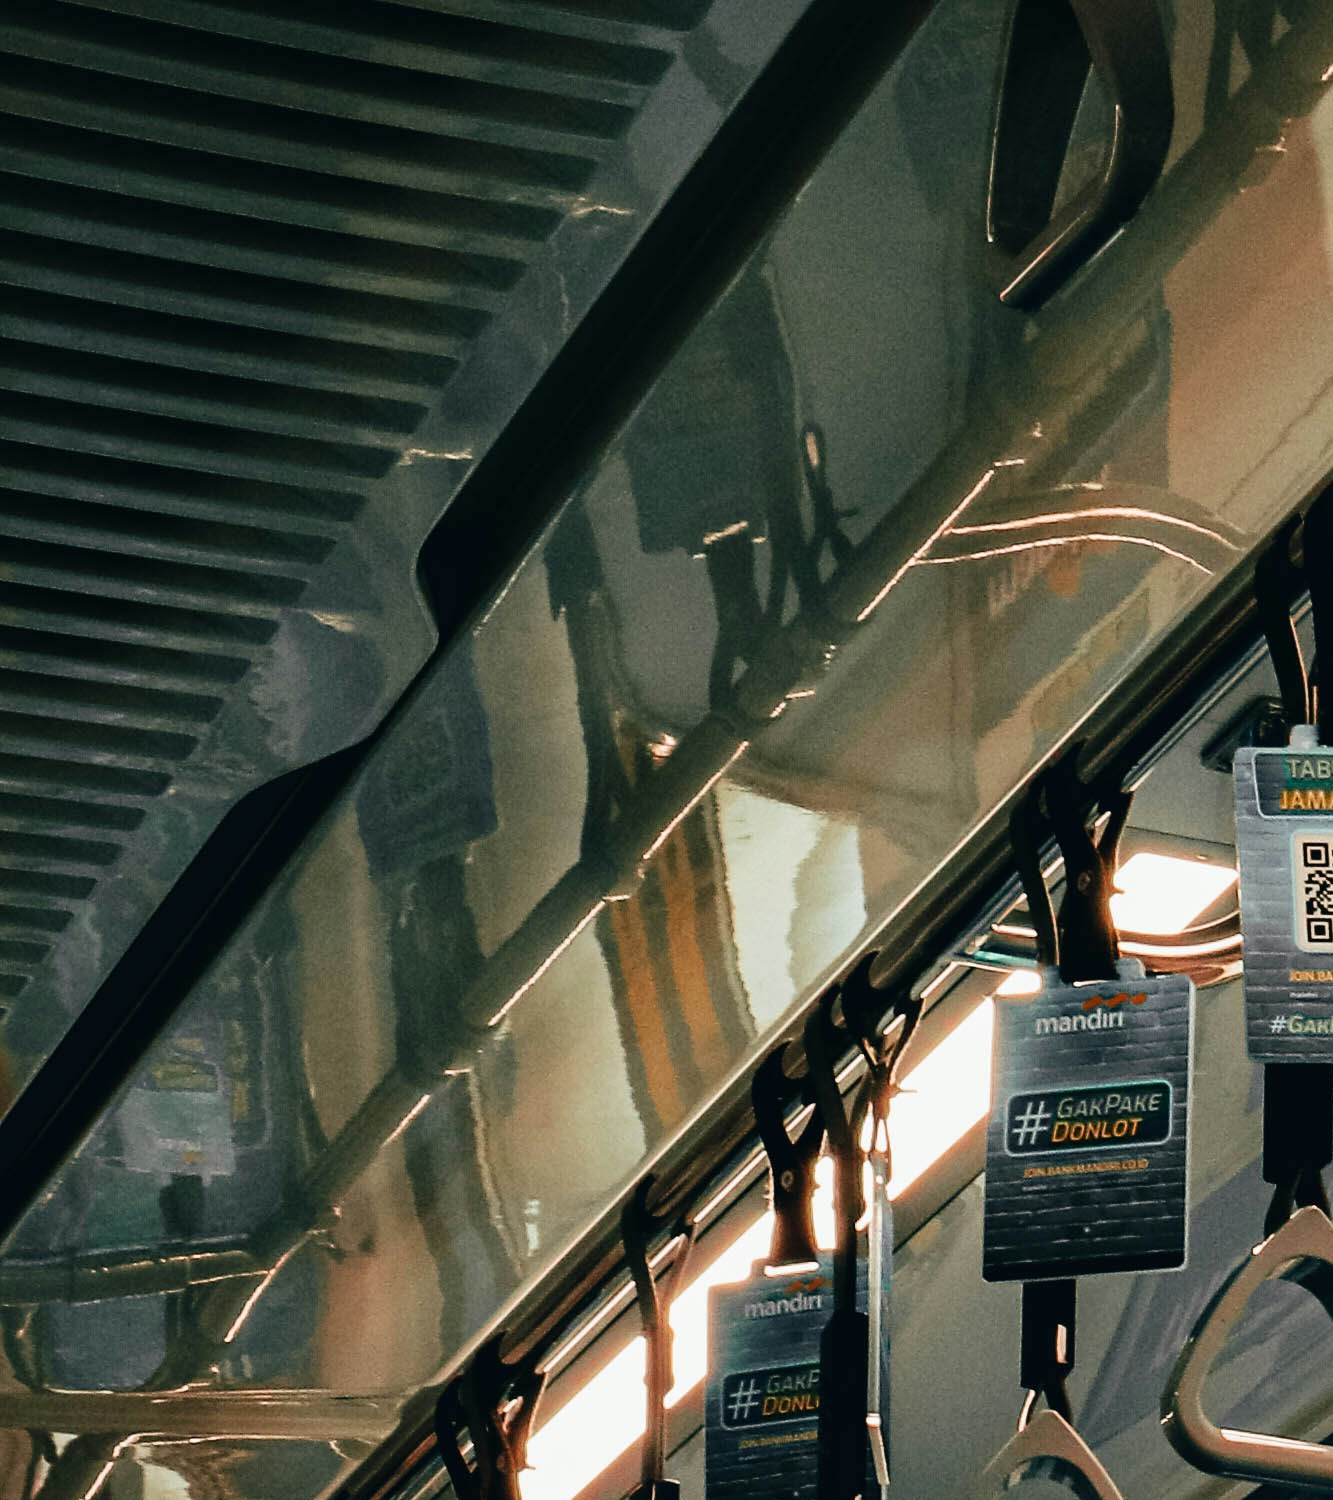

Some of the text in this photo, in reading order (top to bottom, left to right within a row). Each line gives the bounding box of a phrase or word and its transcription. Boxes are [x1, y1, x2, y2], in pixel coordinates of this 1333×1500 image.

[1035, 1007, 1124, 1034] mandiri
[1052, 1118, 1143, 1143] DONLOT
[744, 1292, 822, 1319] mandiri
